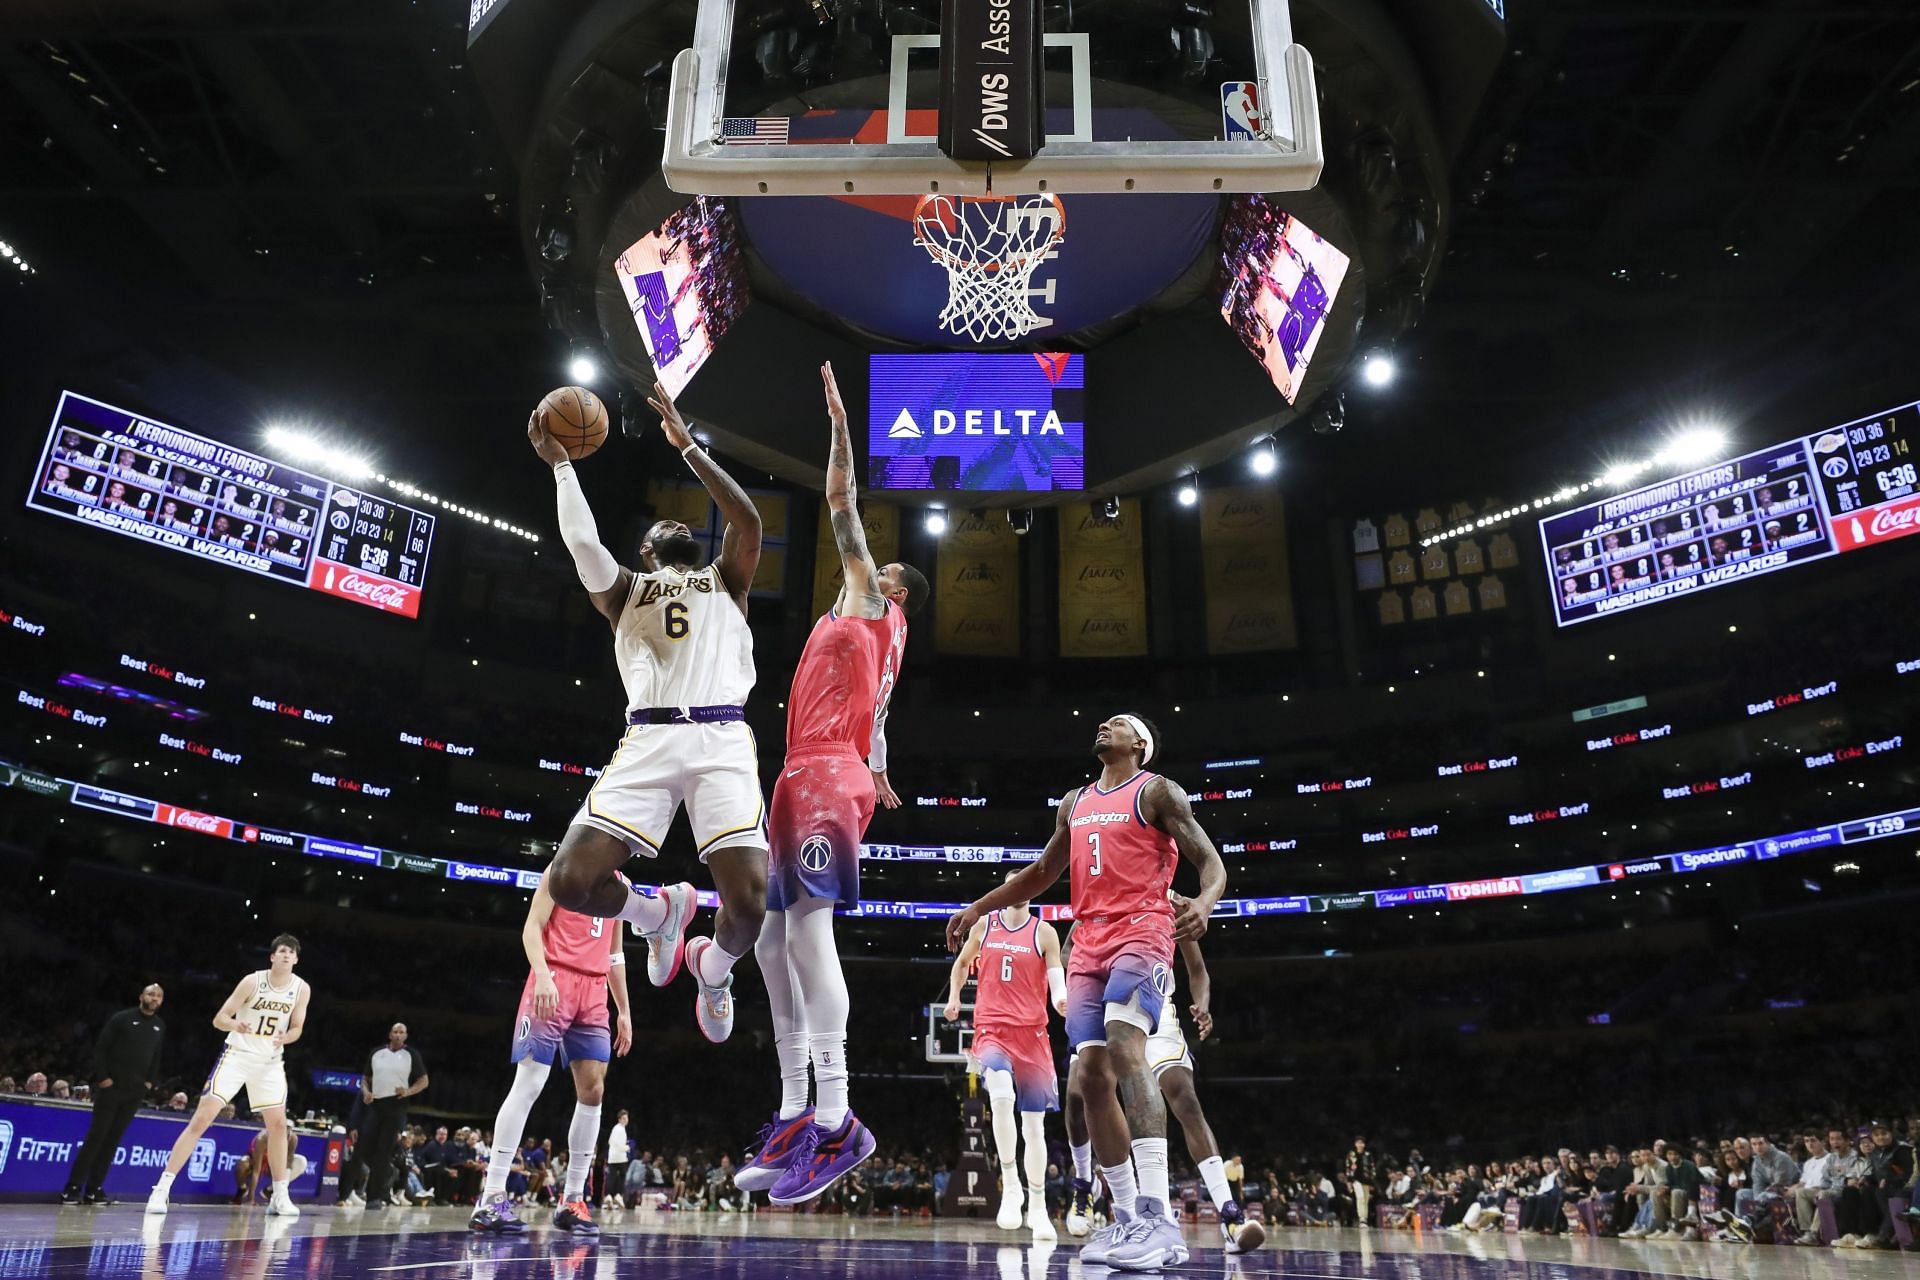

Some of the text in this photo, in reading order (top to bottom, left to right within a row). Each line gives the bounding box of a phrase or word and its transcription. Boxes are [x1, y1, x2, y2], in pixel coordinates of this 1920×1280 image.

[990, 0, 1010, 54] Asse
[1005, 207, 1058, 336] ELTA
[933, 410, 1064, 435] DELTA
[1850, 417, 1896, 445] 30 36 7
[133, 421, 267, 477] REBOUNDING LEADERS
[1856, 438, 1909, 467] 29 23 14
[101, 430, 290, 497] LOS ANGELES LAKERS
[1876, 463, 1917, 492] 6:36
[148, 460, 161, 476] 5
[199, 476, 212, 493] 5
[249, 493, 262, 509] 3
[296, 509, 309, 525] 2
[1604, 465, 1734, 520] REBOUNDING LEADERS
[83, 475, 97, 492] 9
[191, 509, 204, 525] 3
[241, 524, 254, 540] 2
[290, 539, 302, 555] 2
[360, 500, 428, 533] 30 36 7 73
[1583, 521, 1613, 538] LOS
[1694, 474, 1768, 505] LAKERS
[1631, 527, 1641, 544] 5
[1680, 512, 1691, 529] 5
[1732, 496, 1744, 514] 3
[1787, 480, 1799, 498] 2
[77, 505, 188, 547] WASHINGTON
[192, 539, 272, 572] WIZARDS
[355, 520, 368, 535] 29
[368, 524, 381, 539] 23
[383, 528, 394, 543] 14
[360, 543, 389, 568] 6:36
[1589, 572, 1599, 589] 9
[1688, 544, 1699, 561] 3
[1741, 529, 1752, 547] 2
[1796, 513, 1808, 531] 2
[1079, 565, 1125, 581] LAKERS
[1595, 576, 1697, 613] WASHINGTON
[1702, 551, 1788, 583] WIZARDS
[13, 616, 45, 636] Ever?
[664, 601, 691, 643] 6
[1081, 619, 1128, 635] LAKERS
[121, 655, 205, 689] Best Coke Ever?
[18, 691, 106, 728] Best Coke Ever?
[252, 696, 333, 725] Best Coke Ever?
[1747, 682, 1837, 715] Best Coke Ever?
[160, 734, 242, 764] Best Coke Ever?
[400, 732, 474, 757] Best Coke Ever?
[1587, 725, 1671, 750] Best Coke Ever?
[1806, 736, 1902, 768] Best Coke Ever?
[539, 759, 562, 771] Best
[585, 767, 601, 777] Eve
[1438, 756, 1518, 776] Best Coke Ever?
[312, 773, 391, 798] Best Coke Ever?
[1187, 792, 1202, 802] est
[1226, 789, 1253, 799] Ever?
[1297, 777, 1372, 794] Best Coke Ever?
[1663, 773, 1752, 799] Best Coke Ever?
[456, 802, 532, 822] Best Coke Ever?
[917, 797, 987, 806] Best Coke Ever?
[1071, 810, 1130, 828] washington
[1509, 803, 1589, 825] Best Coke Ever?
[1865, 816, 1905, 835] 7:59
[259, 832, 294, 846] TOYOTA
[1223, 839, 1297, 853] Best Coke Ever?
[1362, 825, 1439, 843] Best Coke Ever?
[1780, 832, 1831, 850] crypto.com
[876, 846, 892, 858] 73
[909, 850, 937, 858] Lakers
[952, 848, 1000, 861] 6:36 3
[1087, 832, 1102, 876] 3
[1682, 847, 1746, 870] Spectrum
[455, 864, 508, 881] Spectrum
[1625, 862, 1661, 875] TOYOTA
[1413, 888, 1446, 900] ULTRA
[1451, 880, 1520, 898] TOSHIBA
[865, 904, 907, 914] DELTA
[1258, 901, 1300, 911] crypto.com
[986, 940, 1031, 954] washington
[1001, 955, 1013, 982] 6
[251, 997, 292, 1014] LAKERS
[255, 1015, 279, 1036] 15
[17, 1137, 72, 1163] FIFTH
[129, 1146, 171, 1167] BANK
[217, 1152, 241, 1171] FIF
